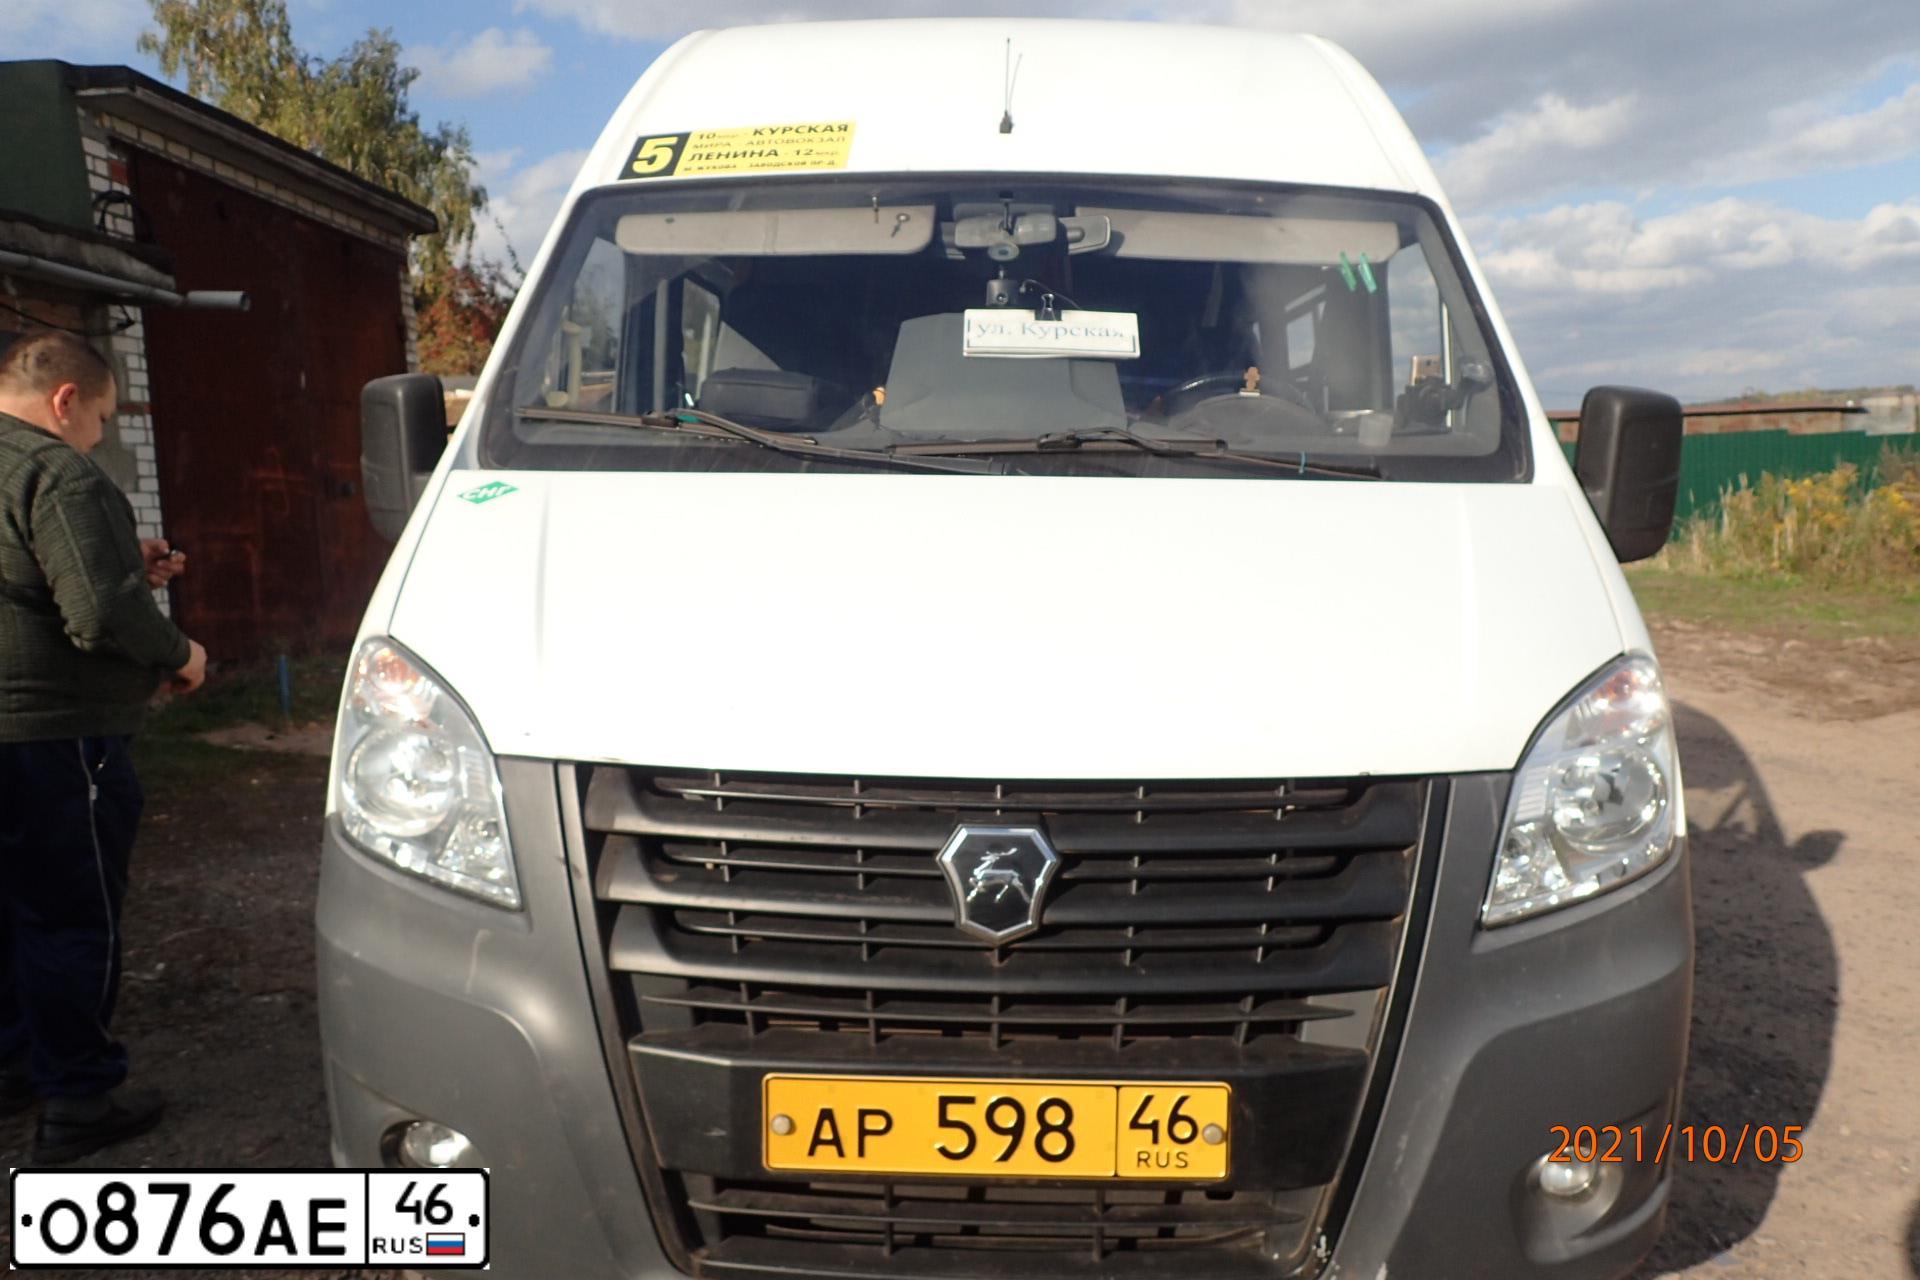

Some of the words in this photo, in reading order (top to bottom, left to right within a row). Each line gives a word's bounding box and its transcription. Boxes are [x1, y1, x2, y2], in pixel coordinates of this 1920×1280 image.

[752, 124, 848, 136] КУРСКАЯ
[632, 137, 679, 174] 5
[688, 149, 779, 161] ЛЕНИНА
[977, 323, 1011, 338] ул.
[1021, 321, 1124, 340] Курская
[806, 1107, 894, 1159] АР
[933, 1094, 1076, 1163] 598
[1128, 1093, 1199, 1145] 46
[1136, 1150, 1189, 1169] RUS
